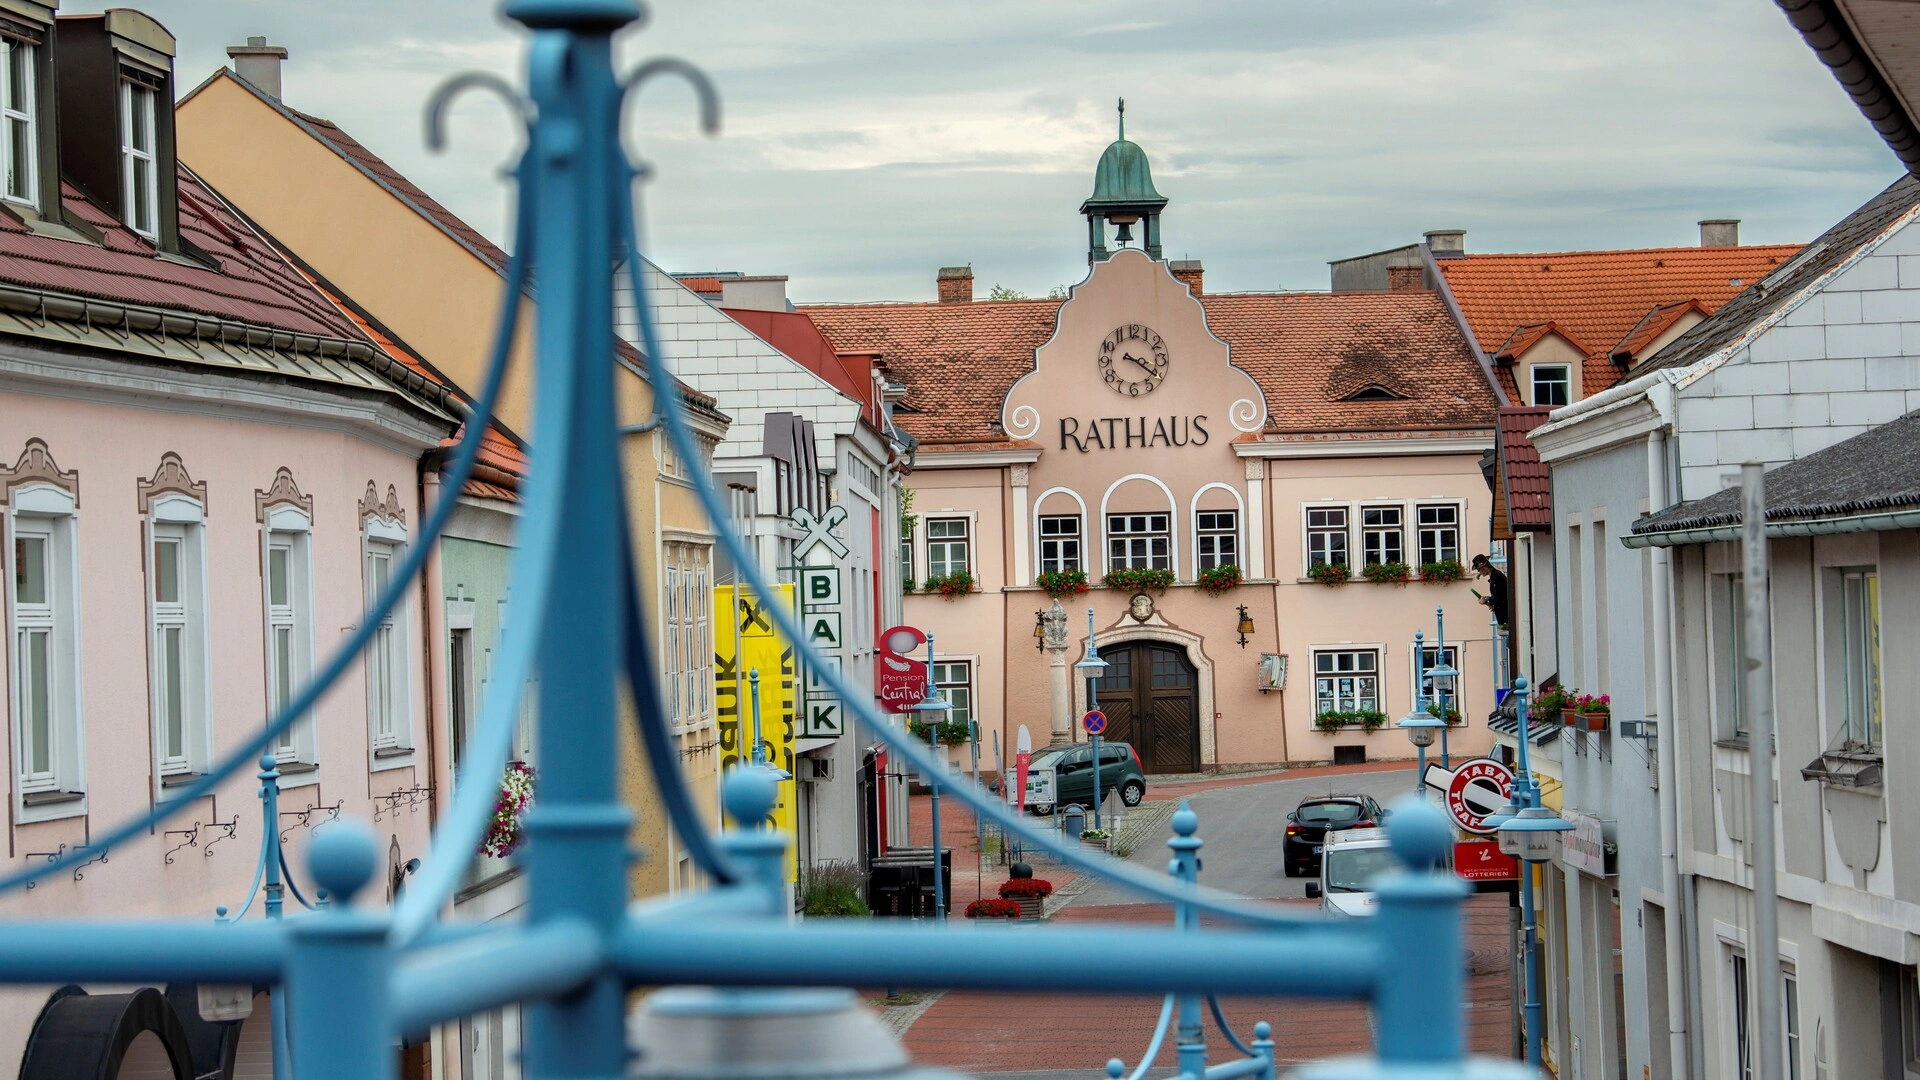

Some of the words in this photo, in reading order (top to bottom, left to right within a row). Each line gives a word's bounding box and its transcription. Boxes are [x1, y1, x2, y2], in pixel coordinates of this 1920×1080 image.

[1116, 327, 1123, 343] 11
[1129, 325, 1139, 339] 12
[1143, 327, 1148, 341] 1
[1103, 340, 1115, 353] 10
[1152, 335, 1162, 349] 2
[1099, 356, 1110, 368] 9
[1156, 353, 1167, 366] 3
[1105, 369, 1115, 383] 8
[1117, 379, 1124, 393] 7
[1130, 382, 1138, 397] 6
[1144, 379, 1154, 392] 5
[1059, 415, 1209, 453] RATHAUS
[882, 674, 925, 682] Pension
[882, 682, 926, 700] Central
[1451, 791, 1479, 827] TRAF
